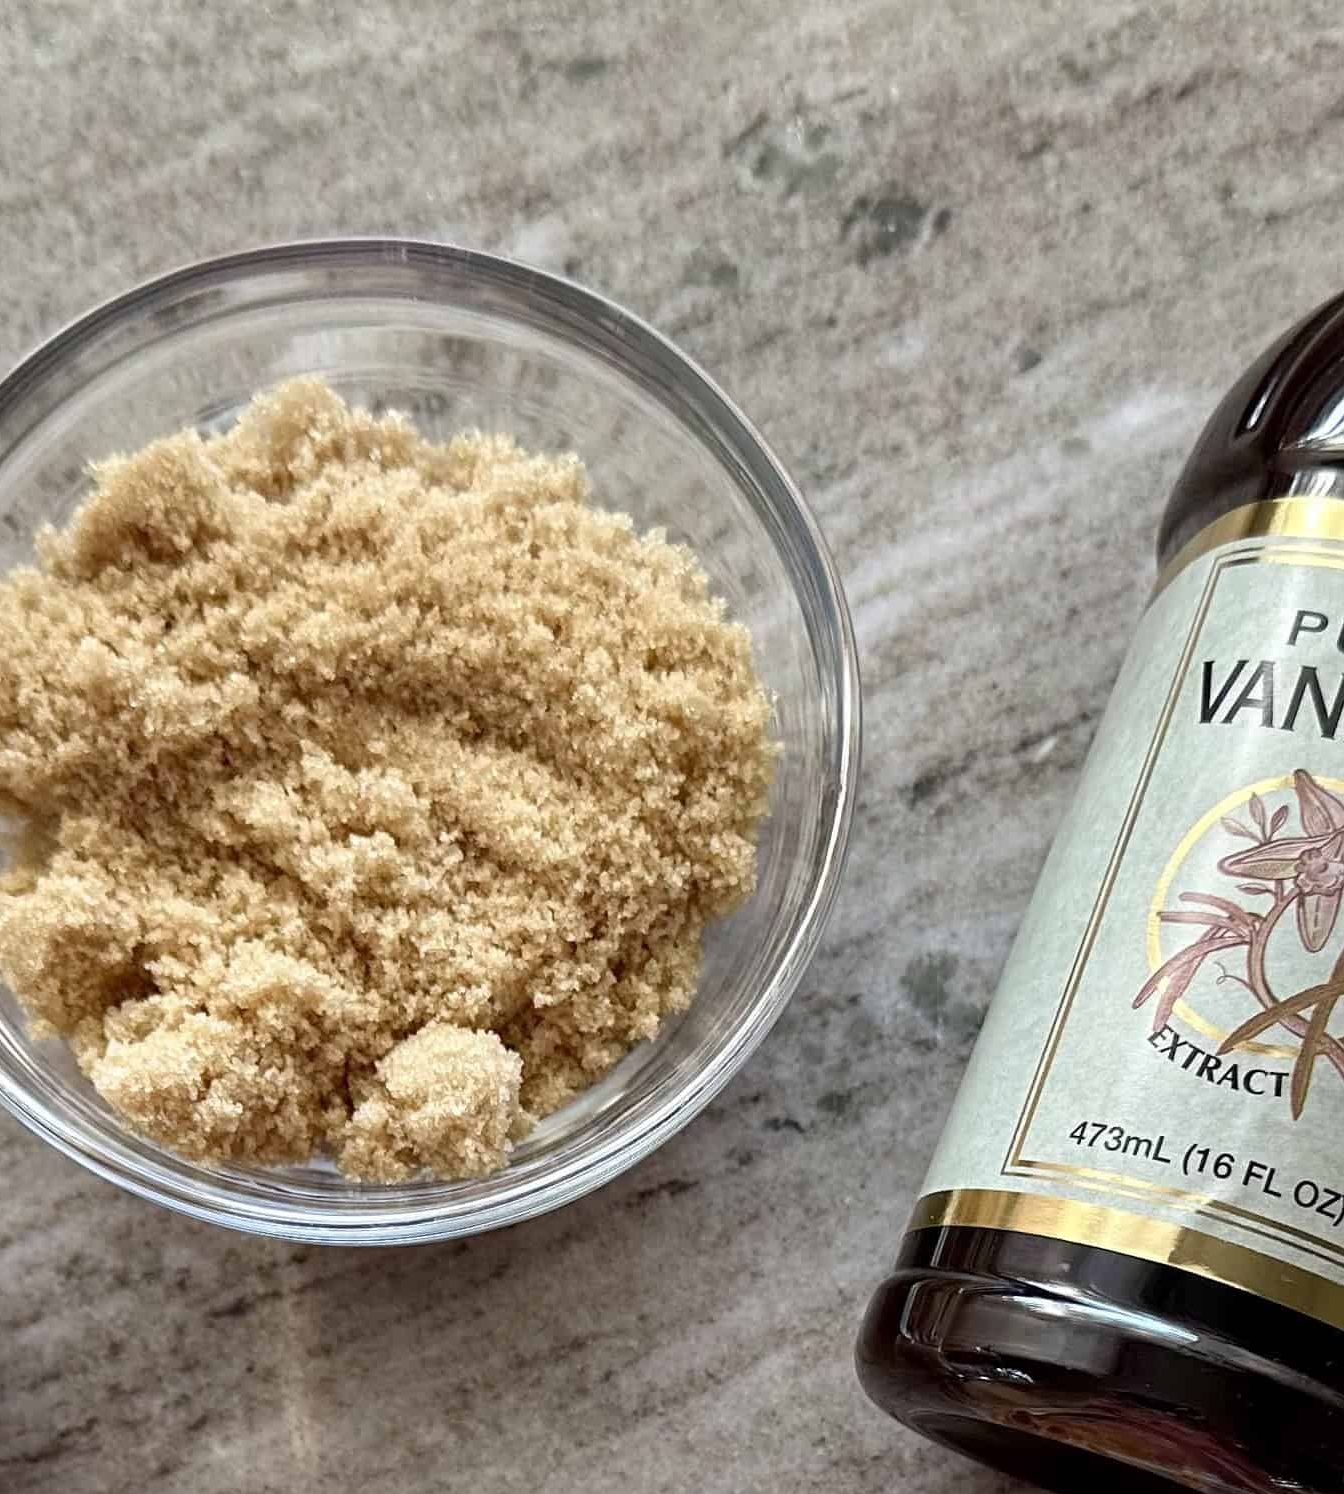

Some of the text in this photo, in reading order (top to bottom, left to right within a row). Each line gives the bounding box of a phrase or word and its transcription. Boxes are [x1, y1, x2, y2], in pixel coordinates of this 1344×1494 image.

[1146, 1024, 1292, 1100] EXTRACT
[1069, 1119, 1173, 1165] 473mL
[1182, 1142, 1234, 1182] (16
[1243, 1161, 1283, 1199] FL
